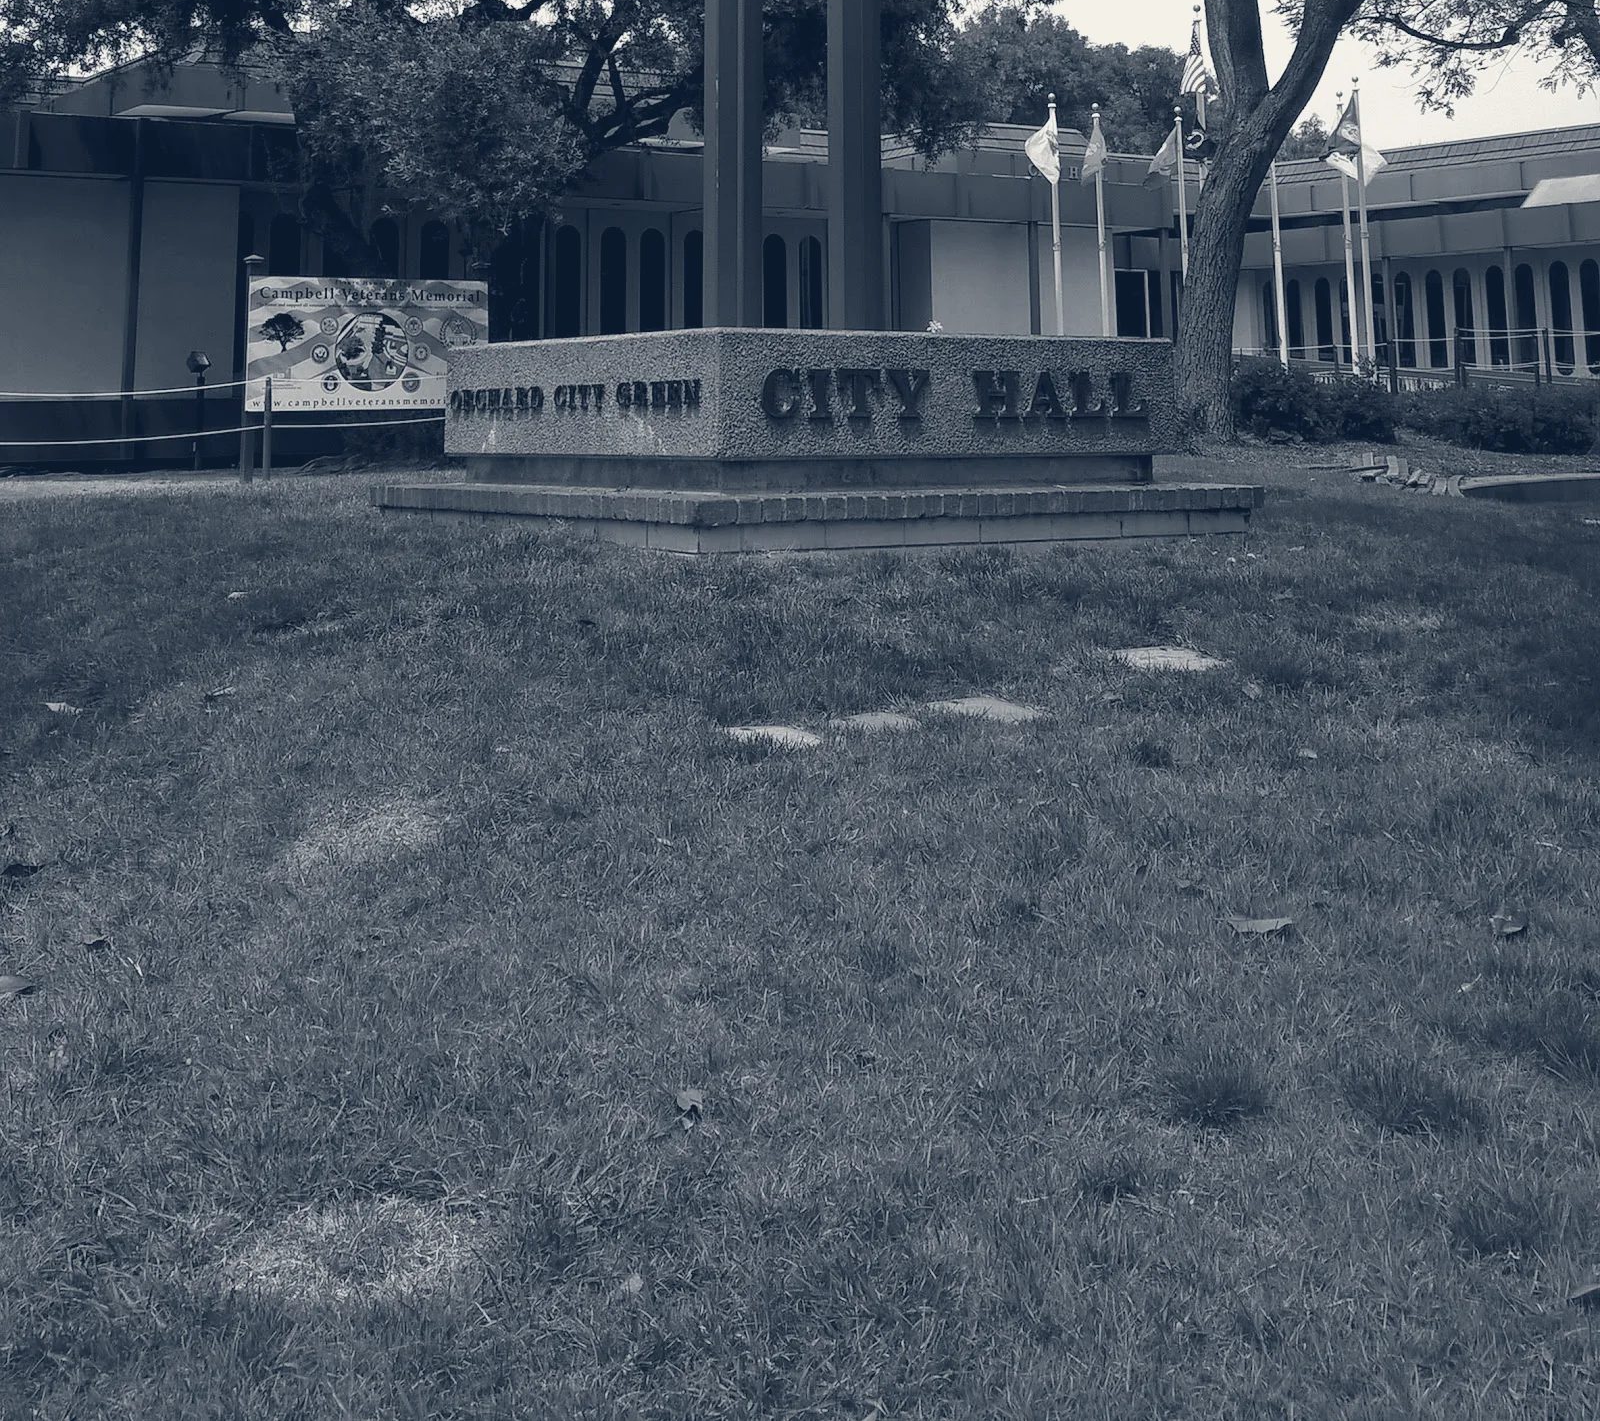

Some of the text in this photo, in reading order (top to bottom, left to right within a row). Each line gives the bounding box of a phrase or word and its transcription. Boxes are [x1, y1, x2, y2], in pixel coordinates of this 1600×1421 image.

[260, 286, 480, 302] Campbell Veterans Memorial
[450, 378, 701, 411] ORCHARD CITY GREEN
[761, 367, 1147, 419] CITY HALL
